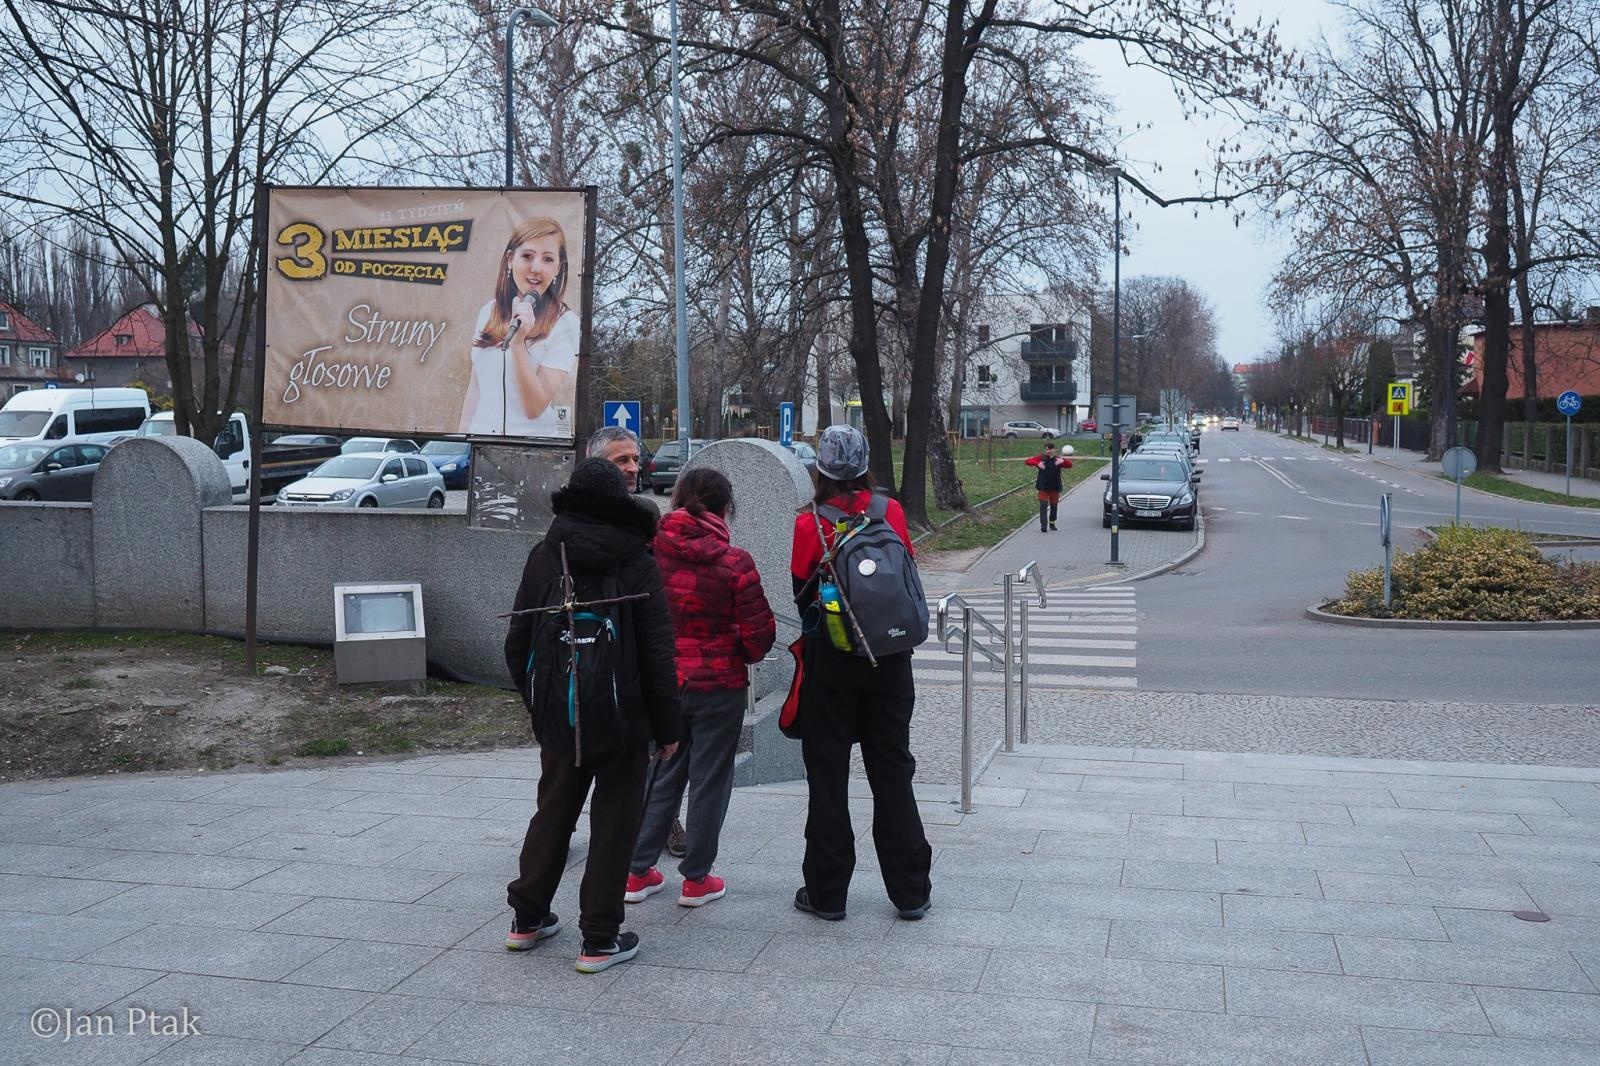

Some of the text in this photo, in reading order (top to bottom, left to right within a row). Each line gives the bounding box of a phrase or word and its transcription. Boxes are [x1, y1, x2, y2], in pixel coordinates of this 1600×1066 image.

[379, 199, 465, 222] 11 TYDZIEŃ
[276, 222, 464, 281] 3 MIESIĄC
[335, 261, 447, 281] OD POCZĘCIA
[345, 304, 447, 362] Struny
